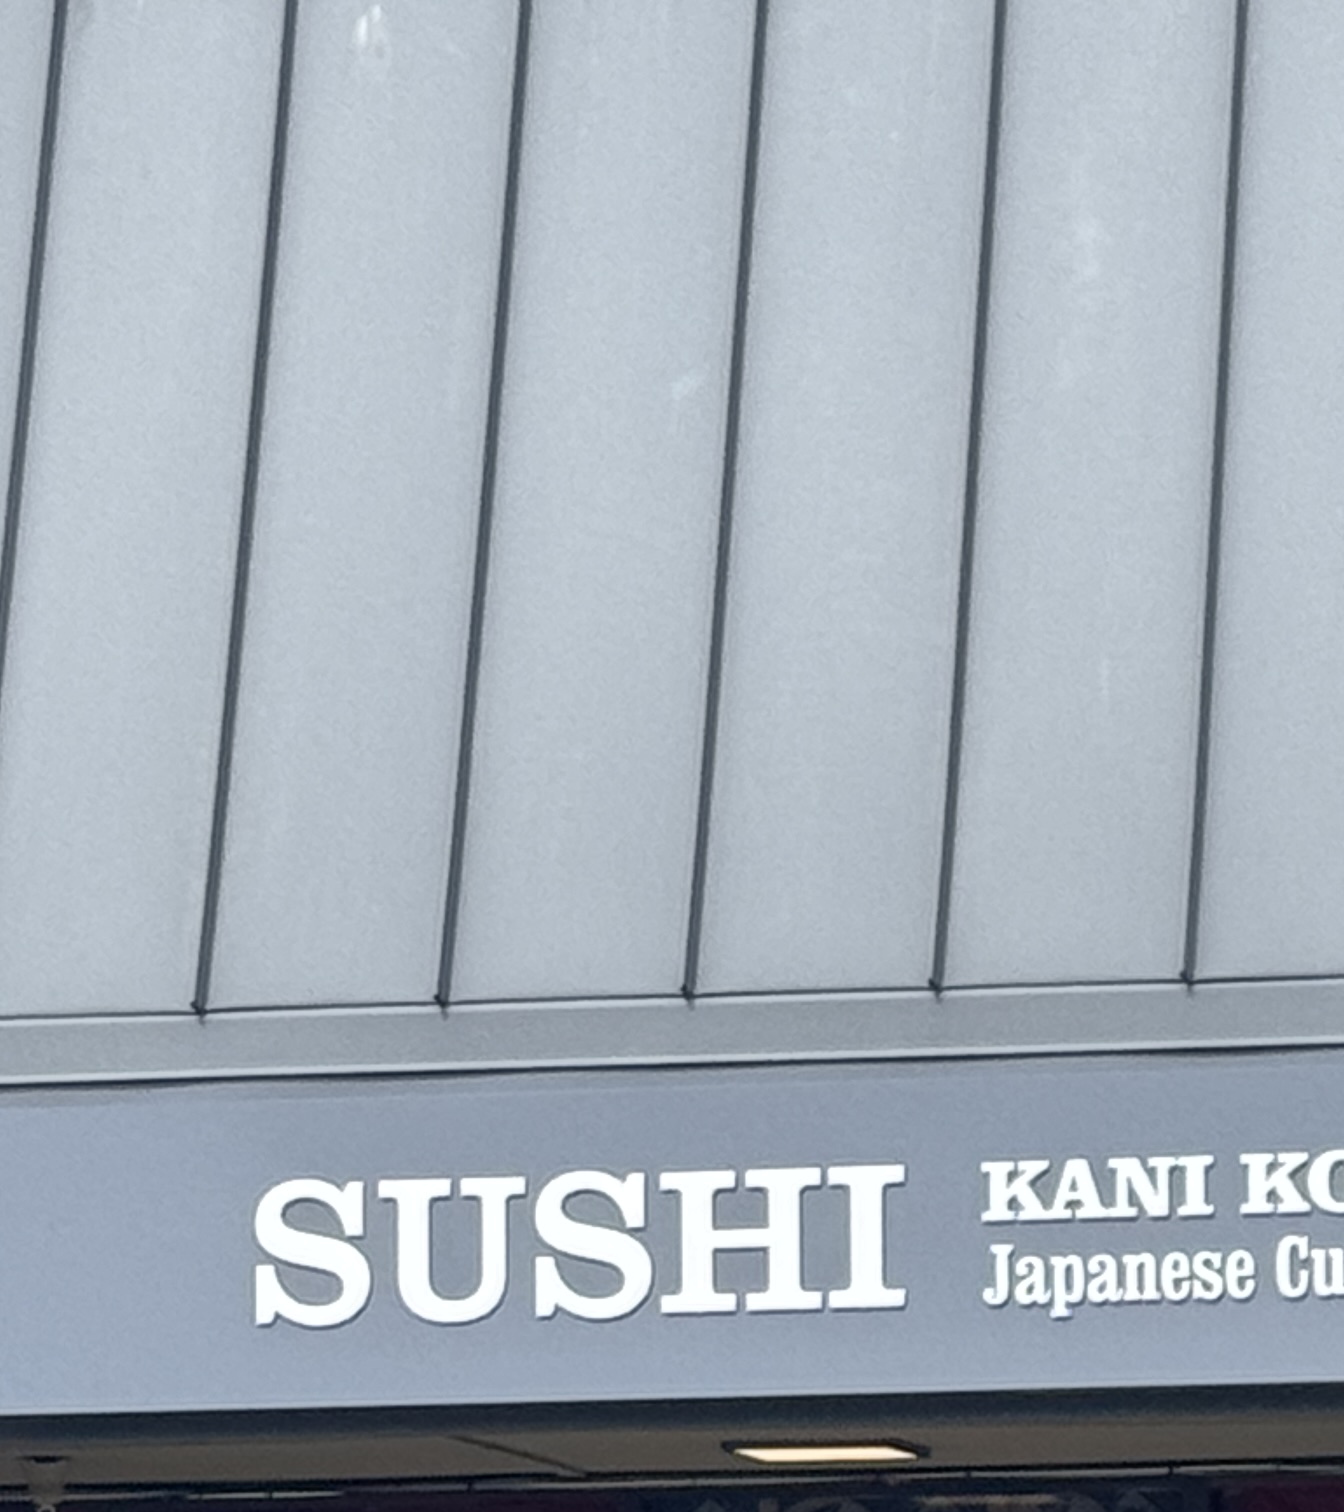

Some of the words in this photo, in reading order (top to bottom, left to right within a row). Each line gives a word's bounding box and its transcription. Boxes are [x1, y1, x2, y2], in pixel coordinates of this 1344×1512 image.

[981, 1155, 1215, 1223] KANI
[255, 1162, 908, 1328] SUSHI
[982, 1243, 1256, 1319] Japanese
